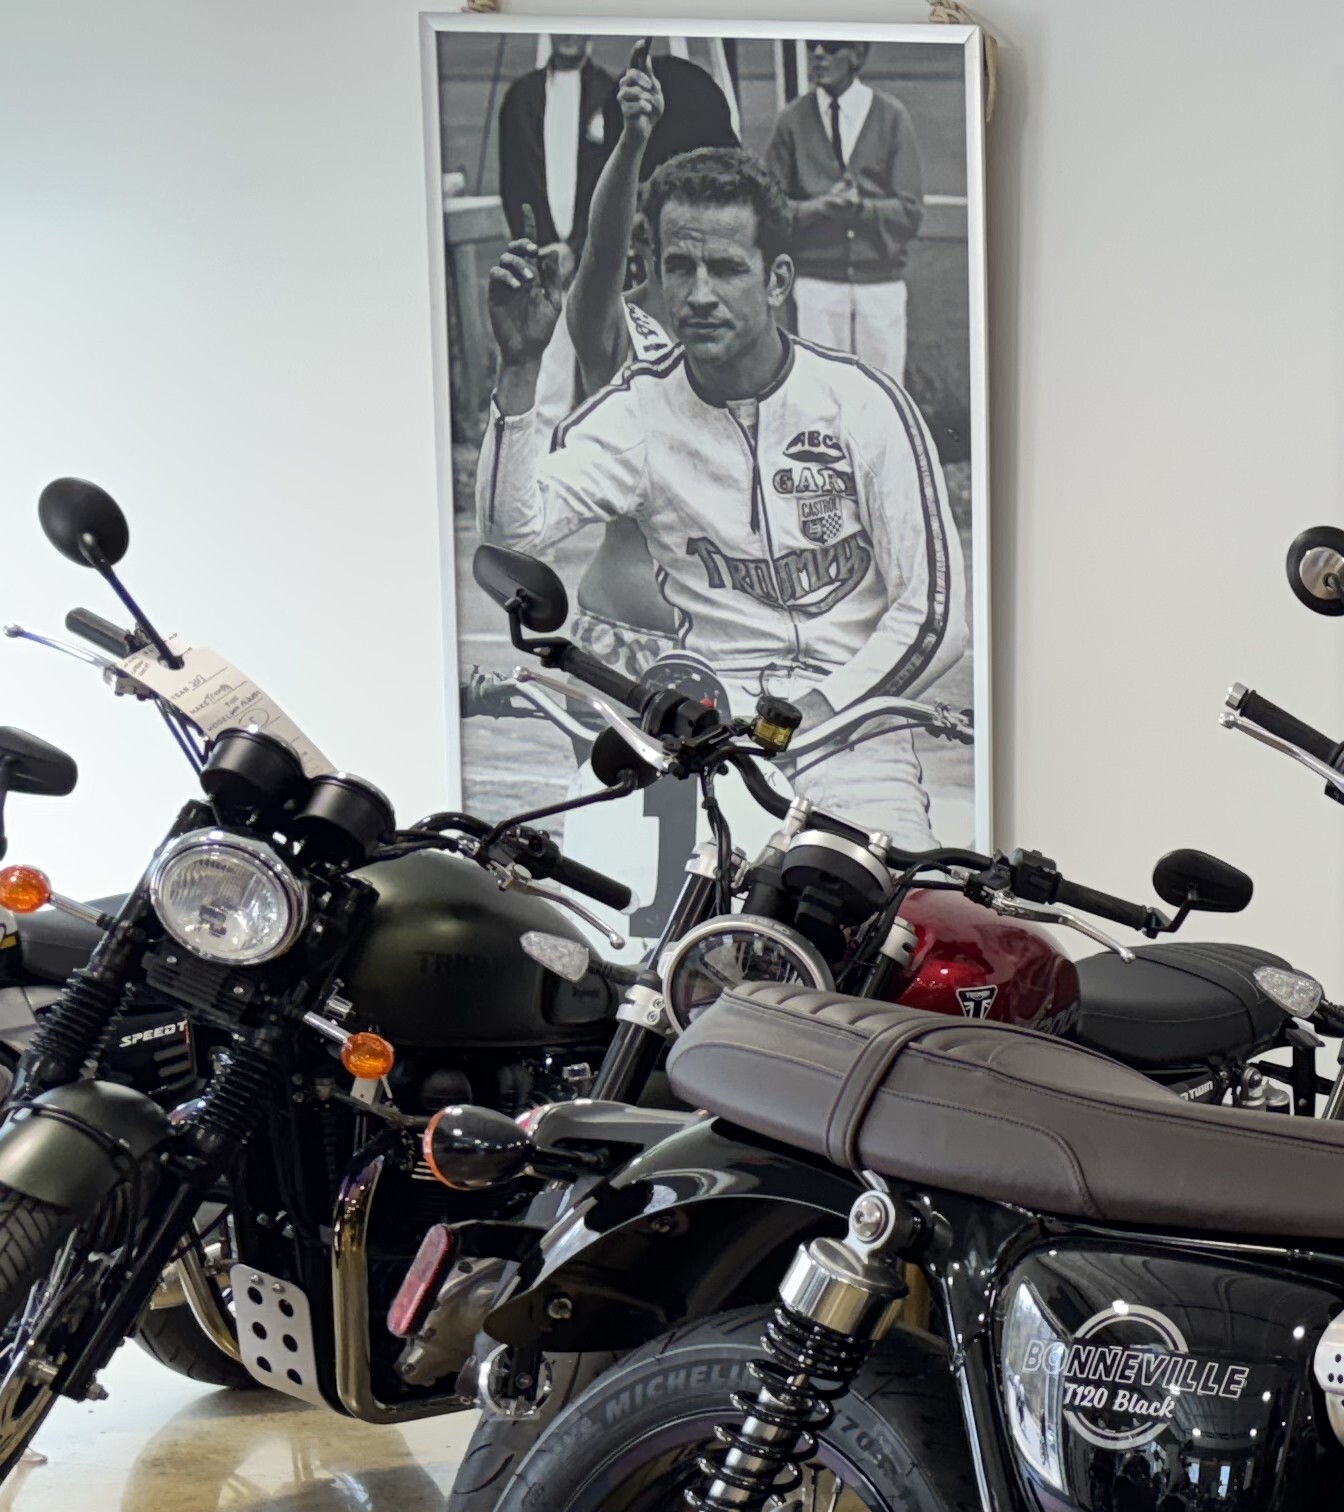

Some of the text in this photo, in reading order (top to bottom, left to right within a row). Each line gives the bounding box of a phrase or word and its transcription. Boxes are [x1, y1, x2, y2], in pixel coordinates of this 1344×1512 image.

[785, 430, 845, 452] ABC
[802, 497, 839, 519] CASTROL
[1022, 1339, 1250, 1399] BONNEVILLE
[1063, 1383, 1176, 1419] T120 Black
